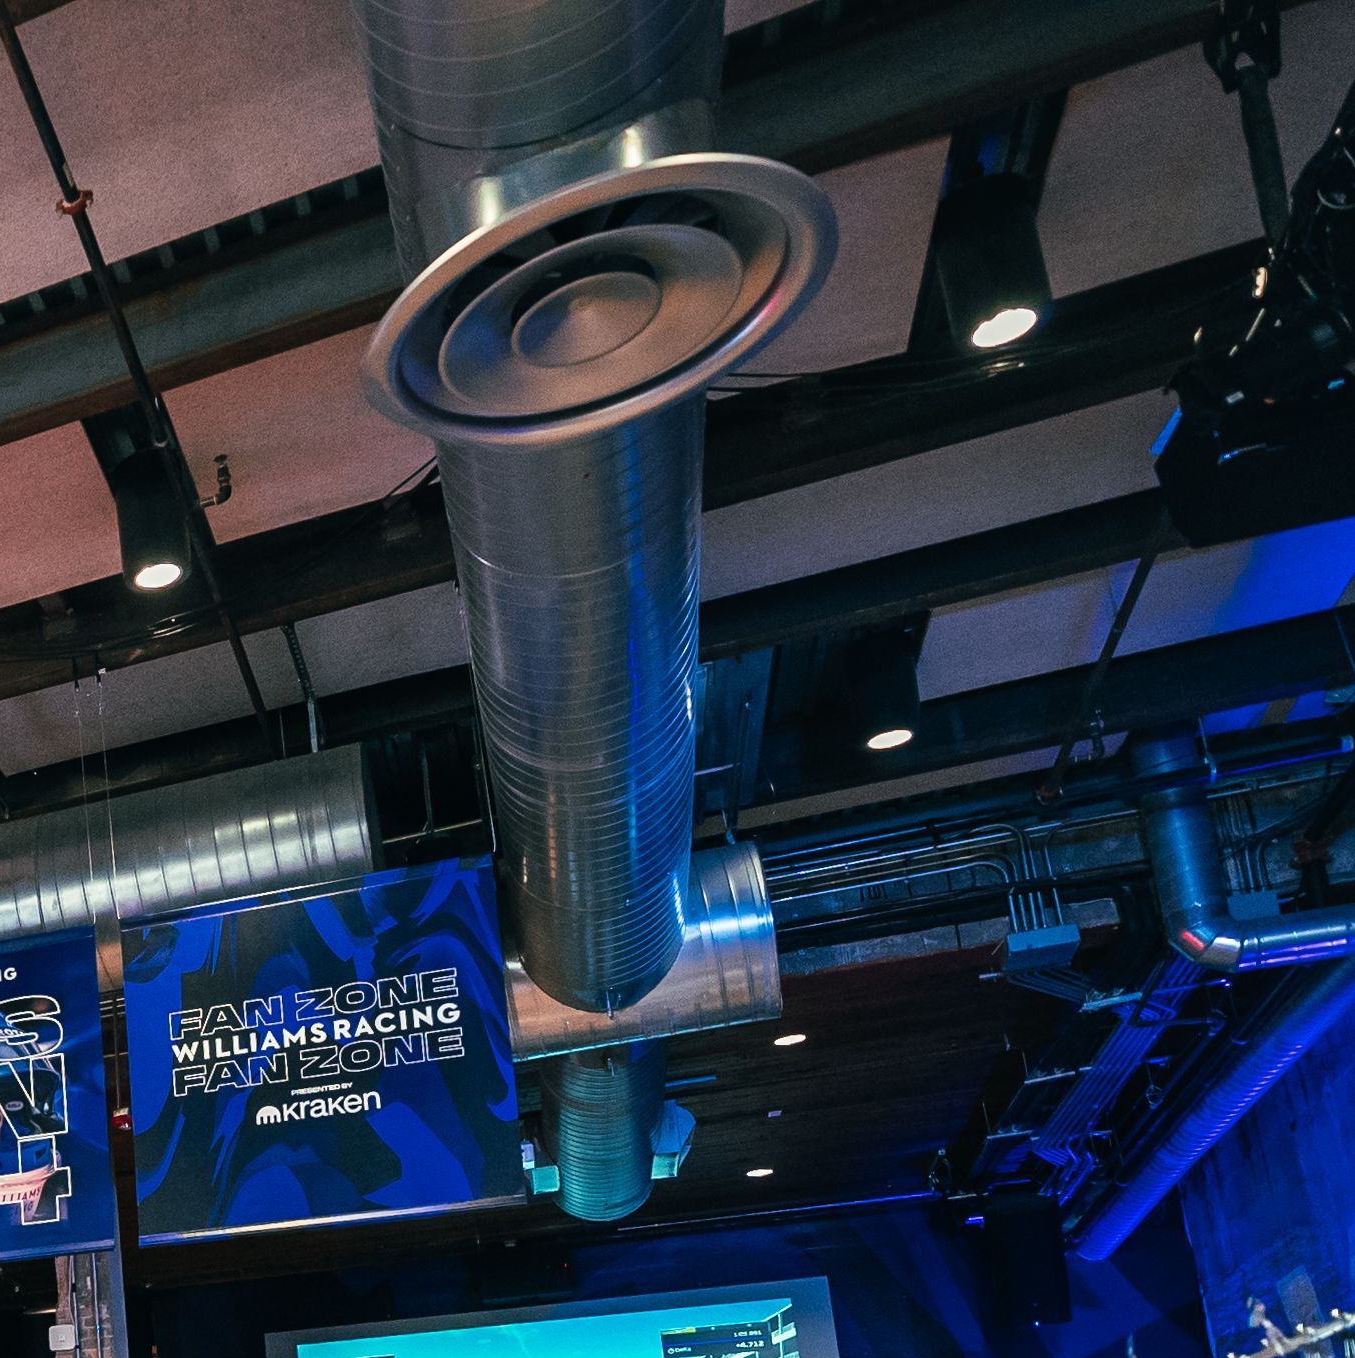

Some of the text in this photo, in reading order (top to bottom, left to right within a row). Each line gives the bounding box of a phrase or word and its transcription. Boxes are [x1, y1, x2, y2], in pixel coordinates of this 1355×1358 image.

[169, 967, 460, 1041] FAN ZONE
[172, 1002, 461, 1063] WILLIAMS RACING
[173, 1027, 465, 1097] FAN ZONE
[282, 1090, 382, 1122] kraken
